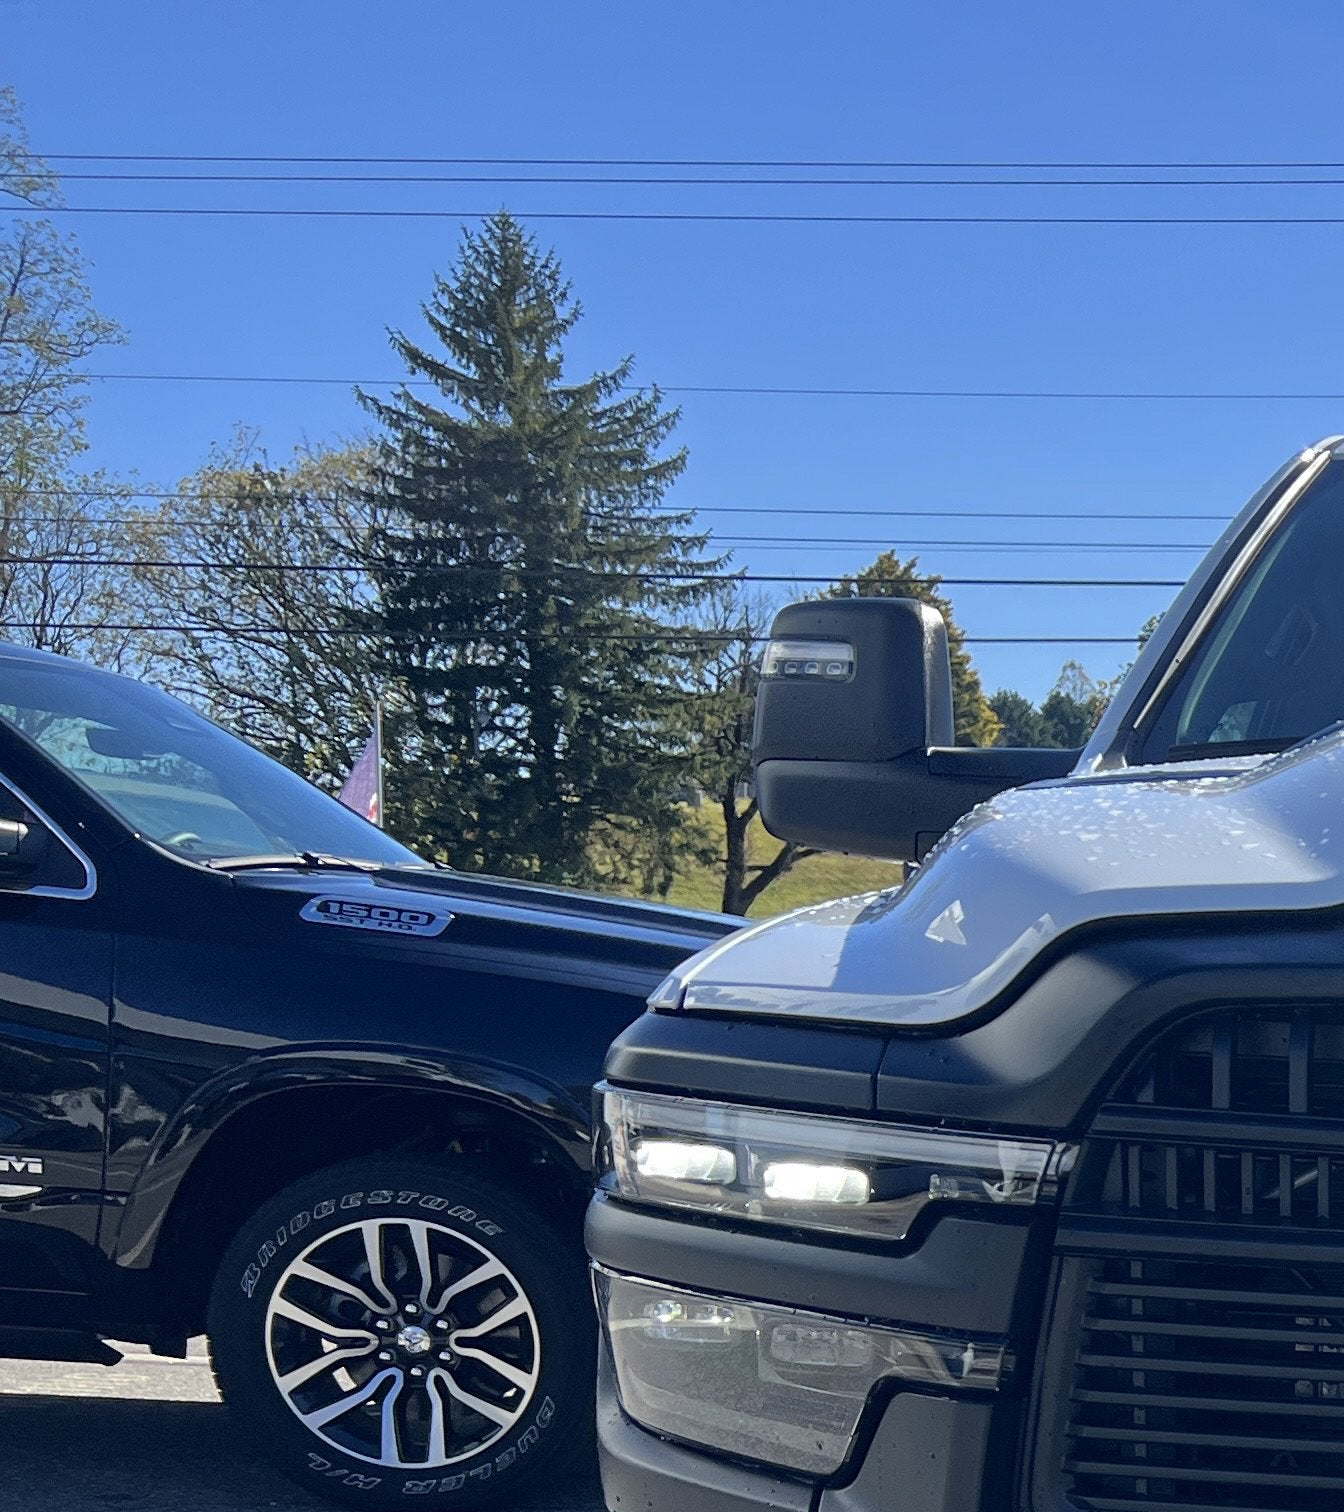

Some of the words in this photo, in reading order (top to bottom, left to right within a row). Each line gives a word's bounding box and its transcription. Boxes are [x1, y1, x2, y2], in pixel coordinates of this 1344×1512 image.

[328, 901, 429, 925] 1500
[240, 1190, 503, 1299] BRIDGESTONE
[307, 1452, 382, 1490] H/L
[402, 1396, 555, 1494] DUELER
